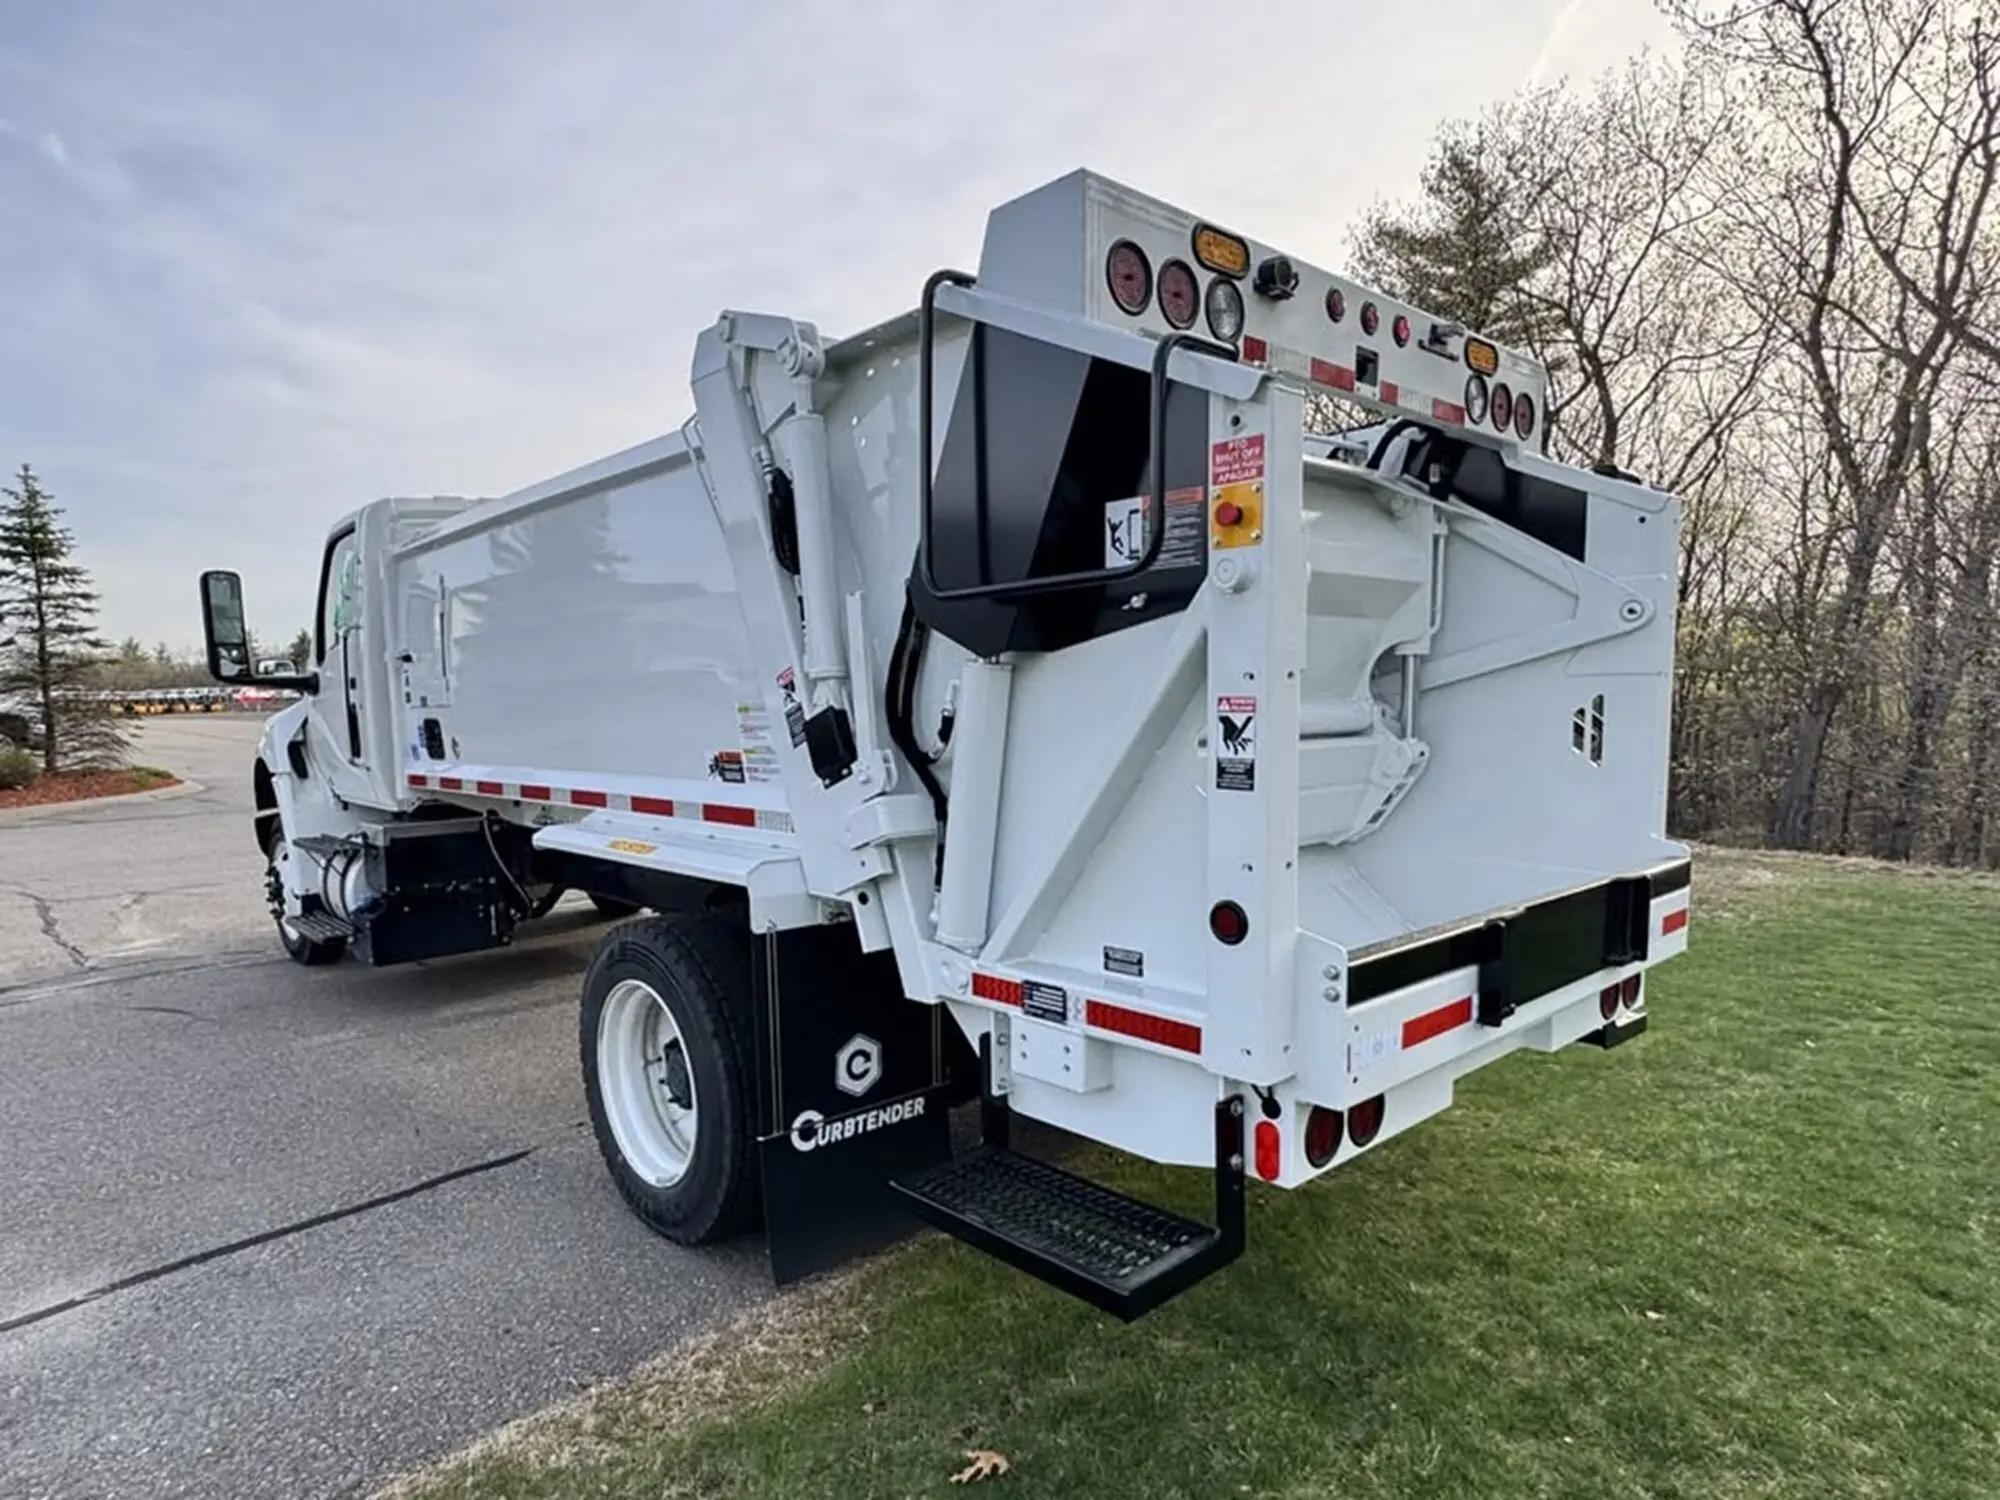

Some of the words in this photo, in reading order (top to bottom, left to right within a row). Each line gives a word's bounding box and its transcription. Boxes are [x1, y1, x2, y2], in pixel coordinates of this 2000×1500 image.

[1228, 439, 1248, 450] PTO
[1241, 446, 1261, 460] OFF
[790, 1097, 926, 1152] CURBTENDER
